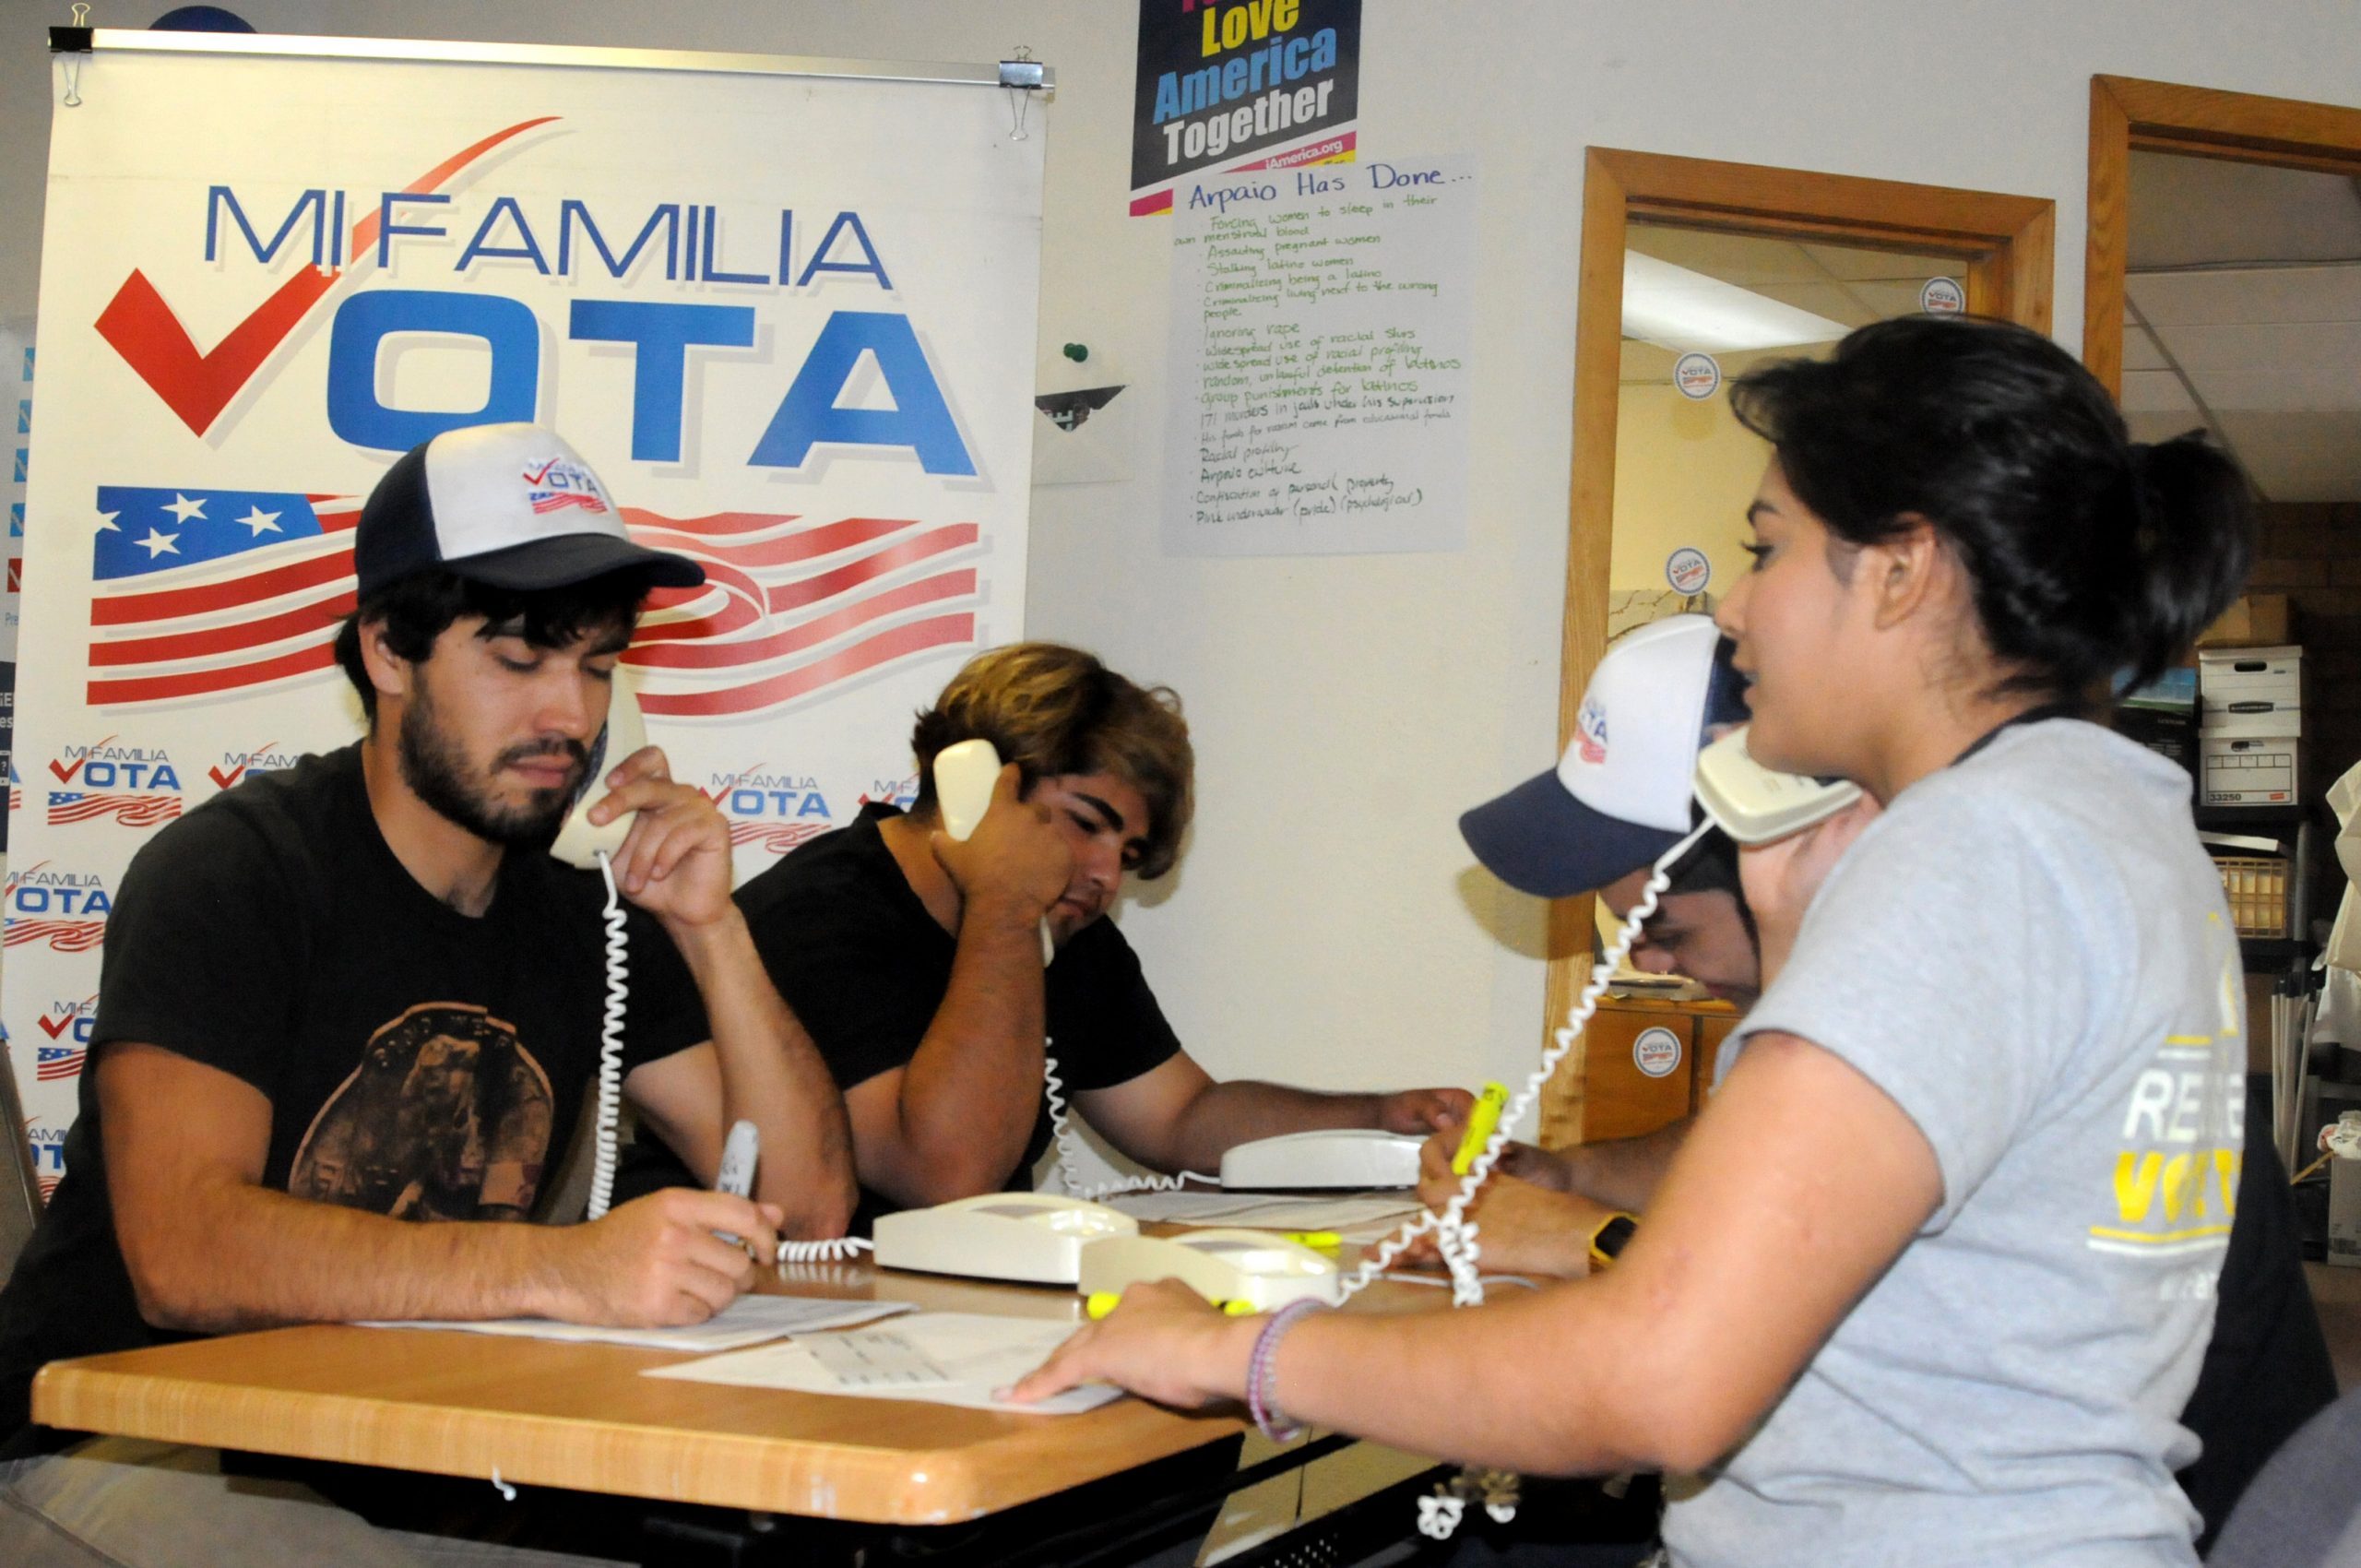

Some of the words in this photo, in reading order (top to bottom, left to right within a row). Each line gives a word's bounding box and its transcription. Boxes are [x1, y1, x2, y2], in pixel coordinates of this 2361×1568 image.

[1202, 0, 1299, 57] Love
[1153, 28, 1336, 125] America
[1163, 79, 1334, 165] Together
[1189, 183, 1276, 214] Arpaio
[1298, 172, 1346, 196] Has
[1210, 216, 1258, 232] Forcing
[1318, 206, 1331, 218] to
[1339, 202, 1373, 217] sleep
[1382, 200, 1394, 209] in
[1403, 194, 1438, 207] their
[204, 184, 345, 269] MI
[377, 192, 893, 291] FAMILIA
[1174, 236, 1195, 246] own
[1276, 226, 1310, 237] blood
[1275, 238, 1329, 255] pregnant
[1335, 235, 1382, 245] women
[1207, 262, 1257, 278] Stalking
[1311, 257, 1354, 267] women
[1288, 274, 1321, 291] being
[1327, 273, 1337, 281] a
[1356, 281, 1368, 292] to
[1373, 279, 1393, 291] the
[1398, 282, 1438, 297] wrong
[1266, 323, 1299, 339] rape
[1279, 339, 1301, 350] use
[1310, 335, 1324, 350] of
[1330, 330, 1374, 343] racial
[1326, 345, 1363, 360] racial
[1379, 360, 1396, 376] of
[1331, 381, 1352, 398] for
[91, 746, 170, 763] FAMILIA
[737, 773, 819, 790] FAMILIA
[23, 872, 102, 887] FAMILIA
